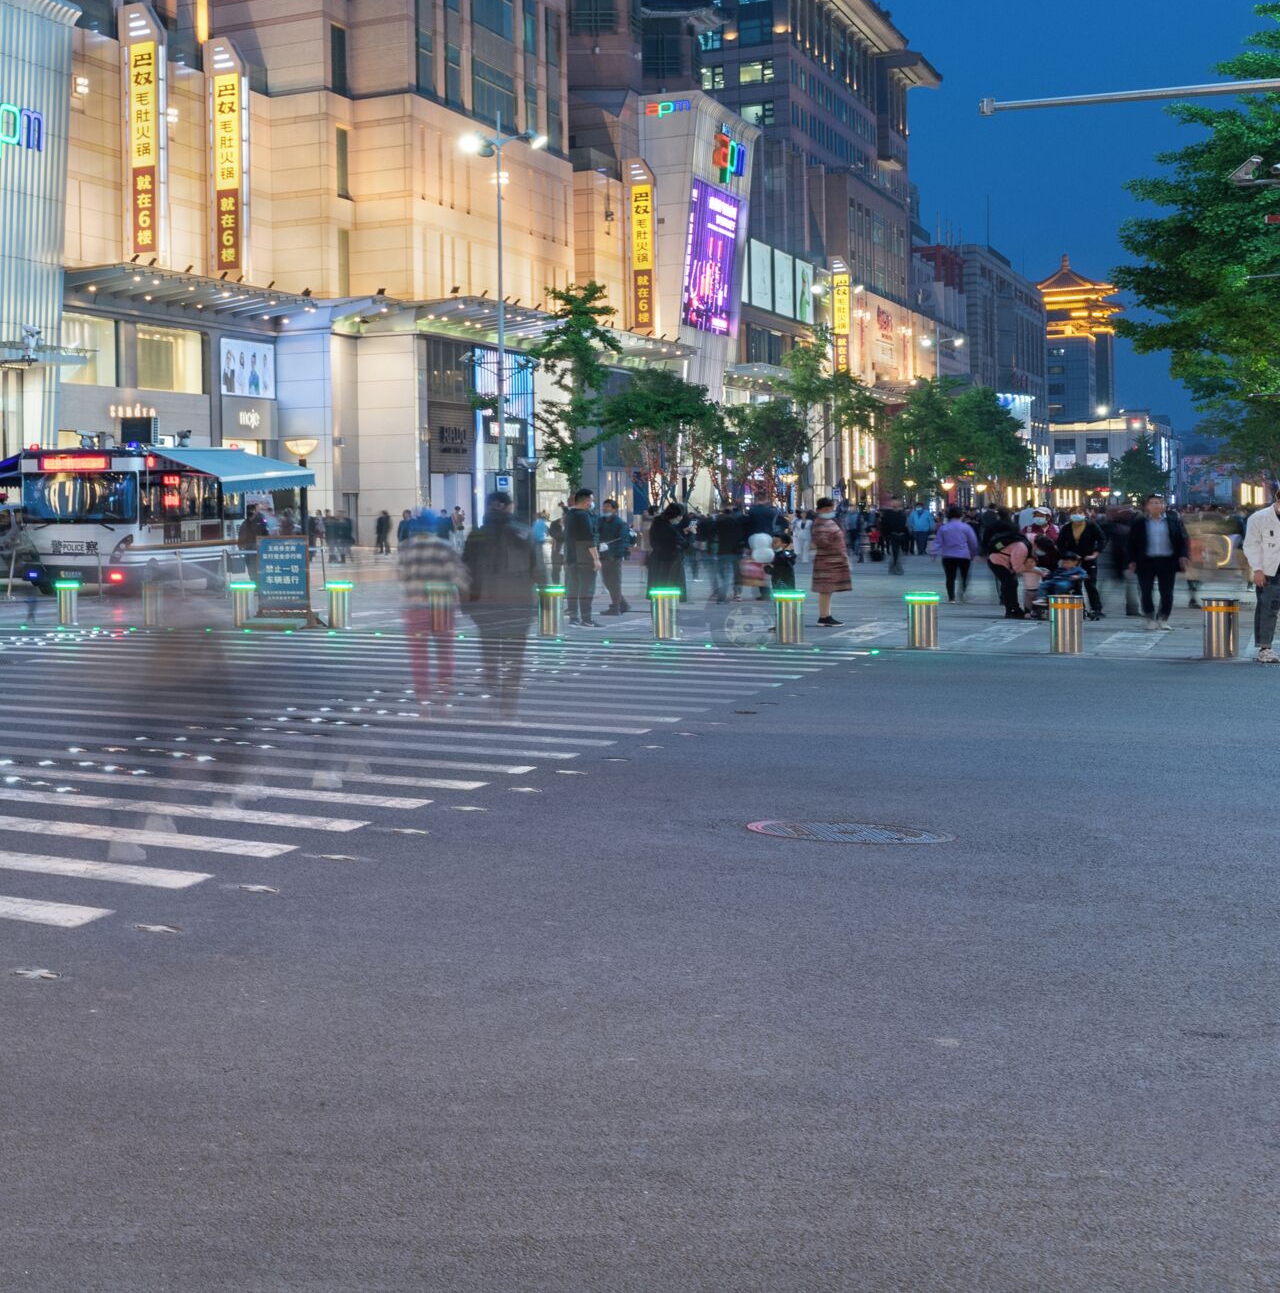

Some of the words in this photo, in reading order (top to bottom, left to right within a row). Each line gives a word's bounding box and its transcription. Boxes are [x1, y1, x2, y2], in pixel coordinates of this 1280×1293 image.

[133, 51, 153, 157] 巴奴毛肚火锅
[217, 83, 237, 180] 巴奴毛肚火锅
[645, 98, 690, 119] apm
[712, 133, 746, 184] apm
[136, 174, 152, 246] 就在6楼
[220, 196, 236, 263] 就在6楼
[109, 403, 157, 418] sandro
